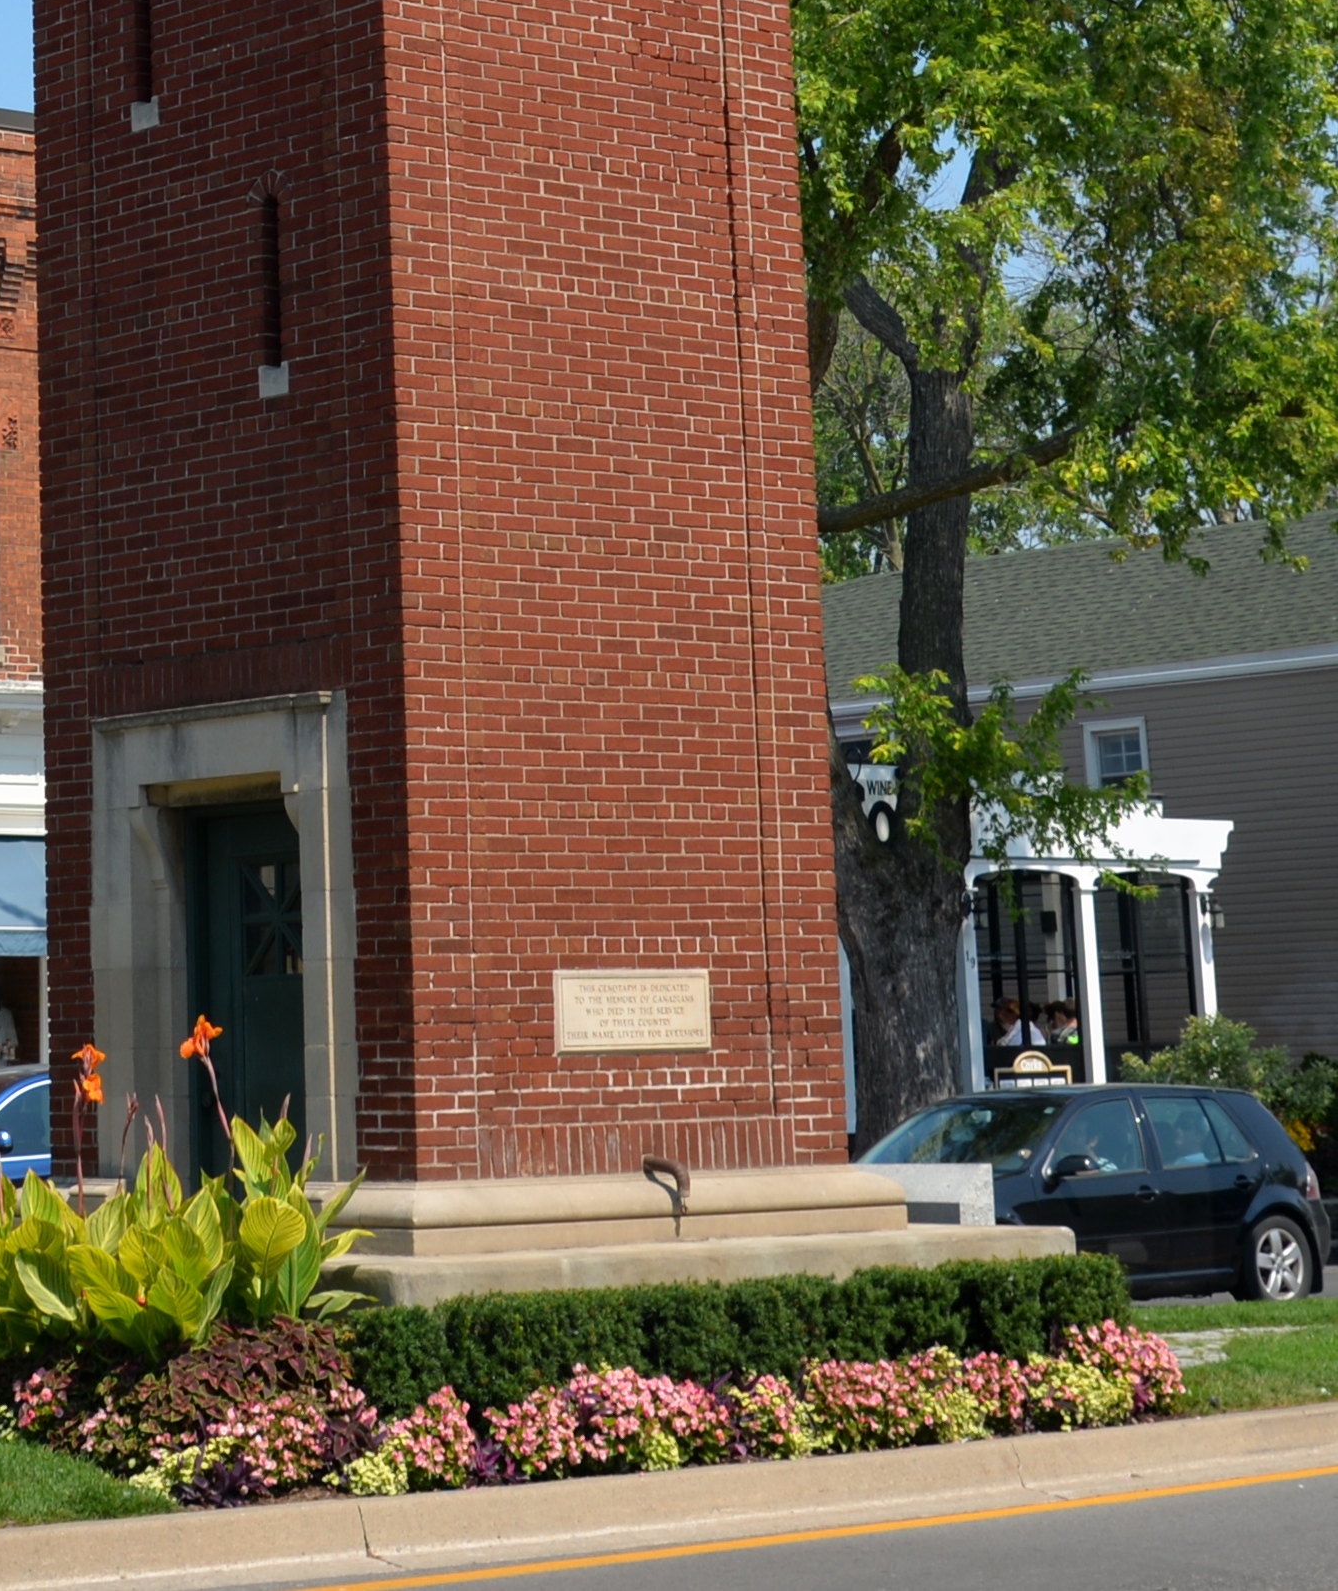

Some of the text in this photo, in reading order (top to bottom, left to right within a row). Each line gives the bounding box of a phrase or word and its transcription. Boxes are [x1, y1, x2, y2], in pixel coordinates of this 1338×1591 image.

[575, 996, 584, 1005] TO
[589, 996, 602, 1004] THE
[606, 996, 637, 1004] MEMORY
[586, 1008, 604, 1016] WHO
[640, 1007, 653, 1015] THE
[657, 1007, 685, 1015] SERVICE
[599, 1018, 671, 1027] OF THEIR COUNTRY
[567, 1031, 589, 1040] THEIR
[592, 1031, 614, 1039] NAME
[618, 1030, 645, 1039] LIVETH
[648, 1030, 662, 1038] FOR
